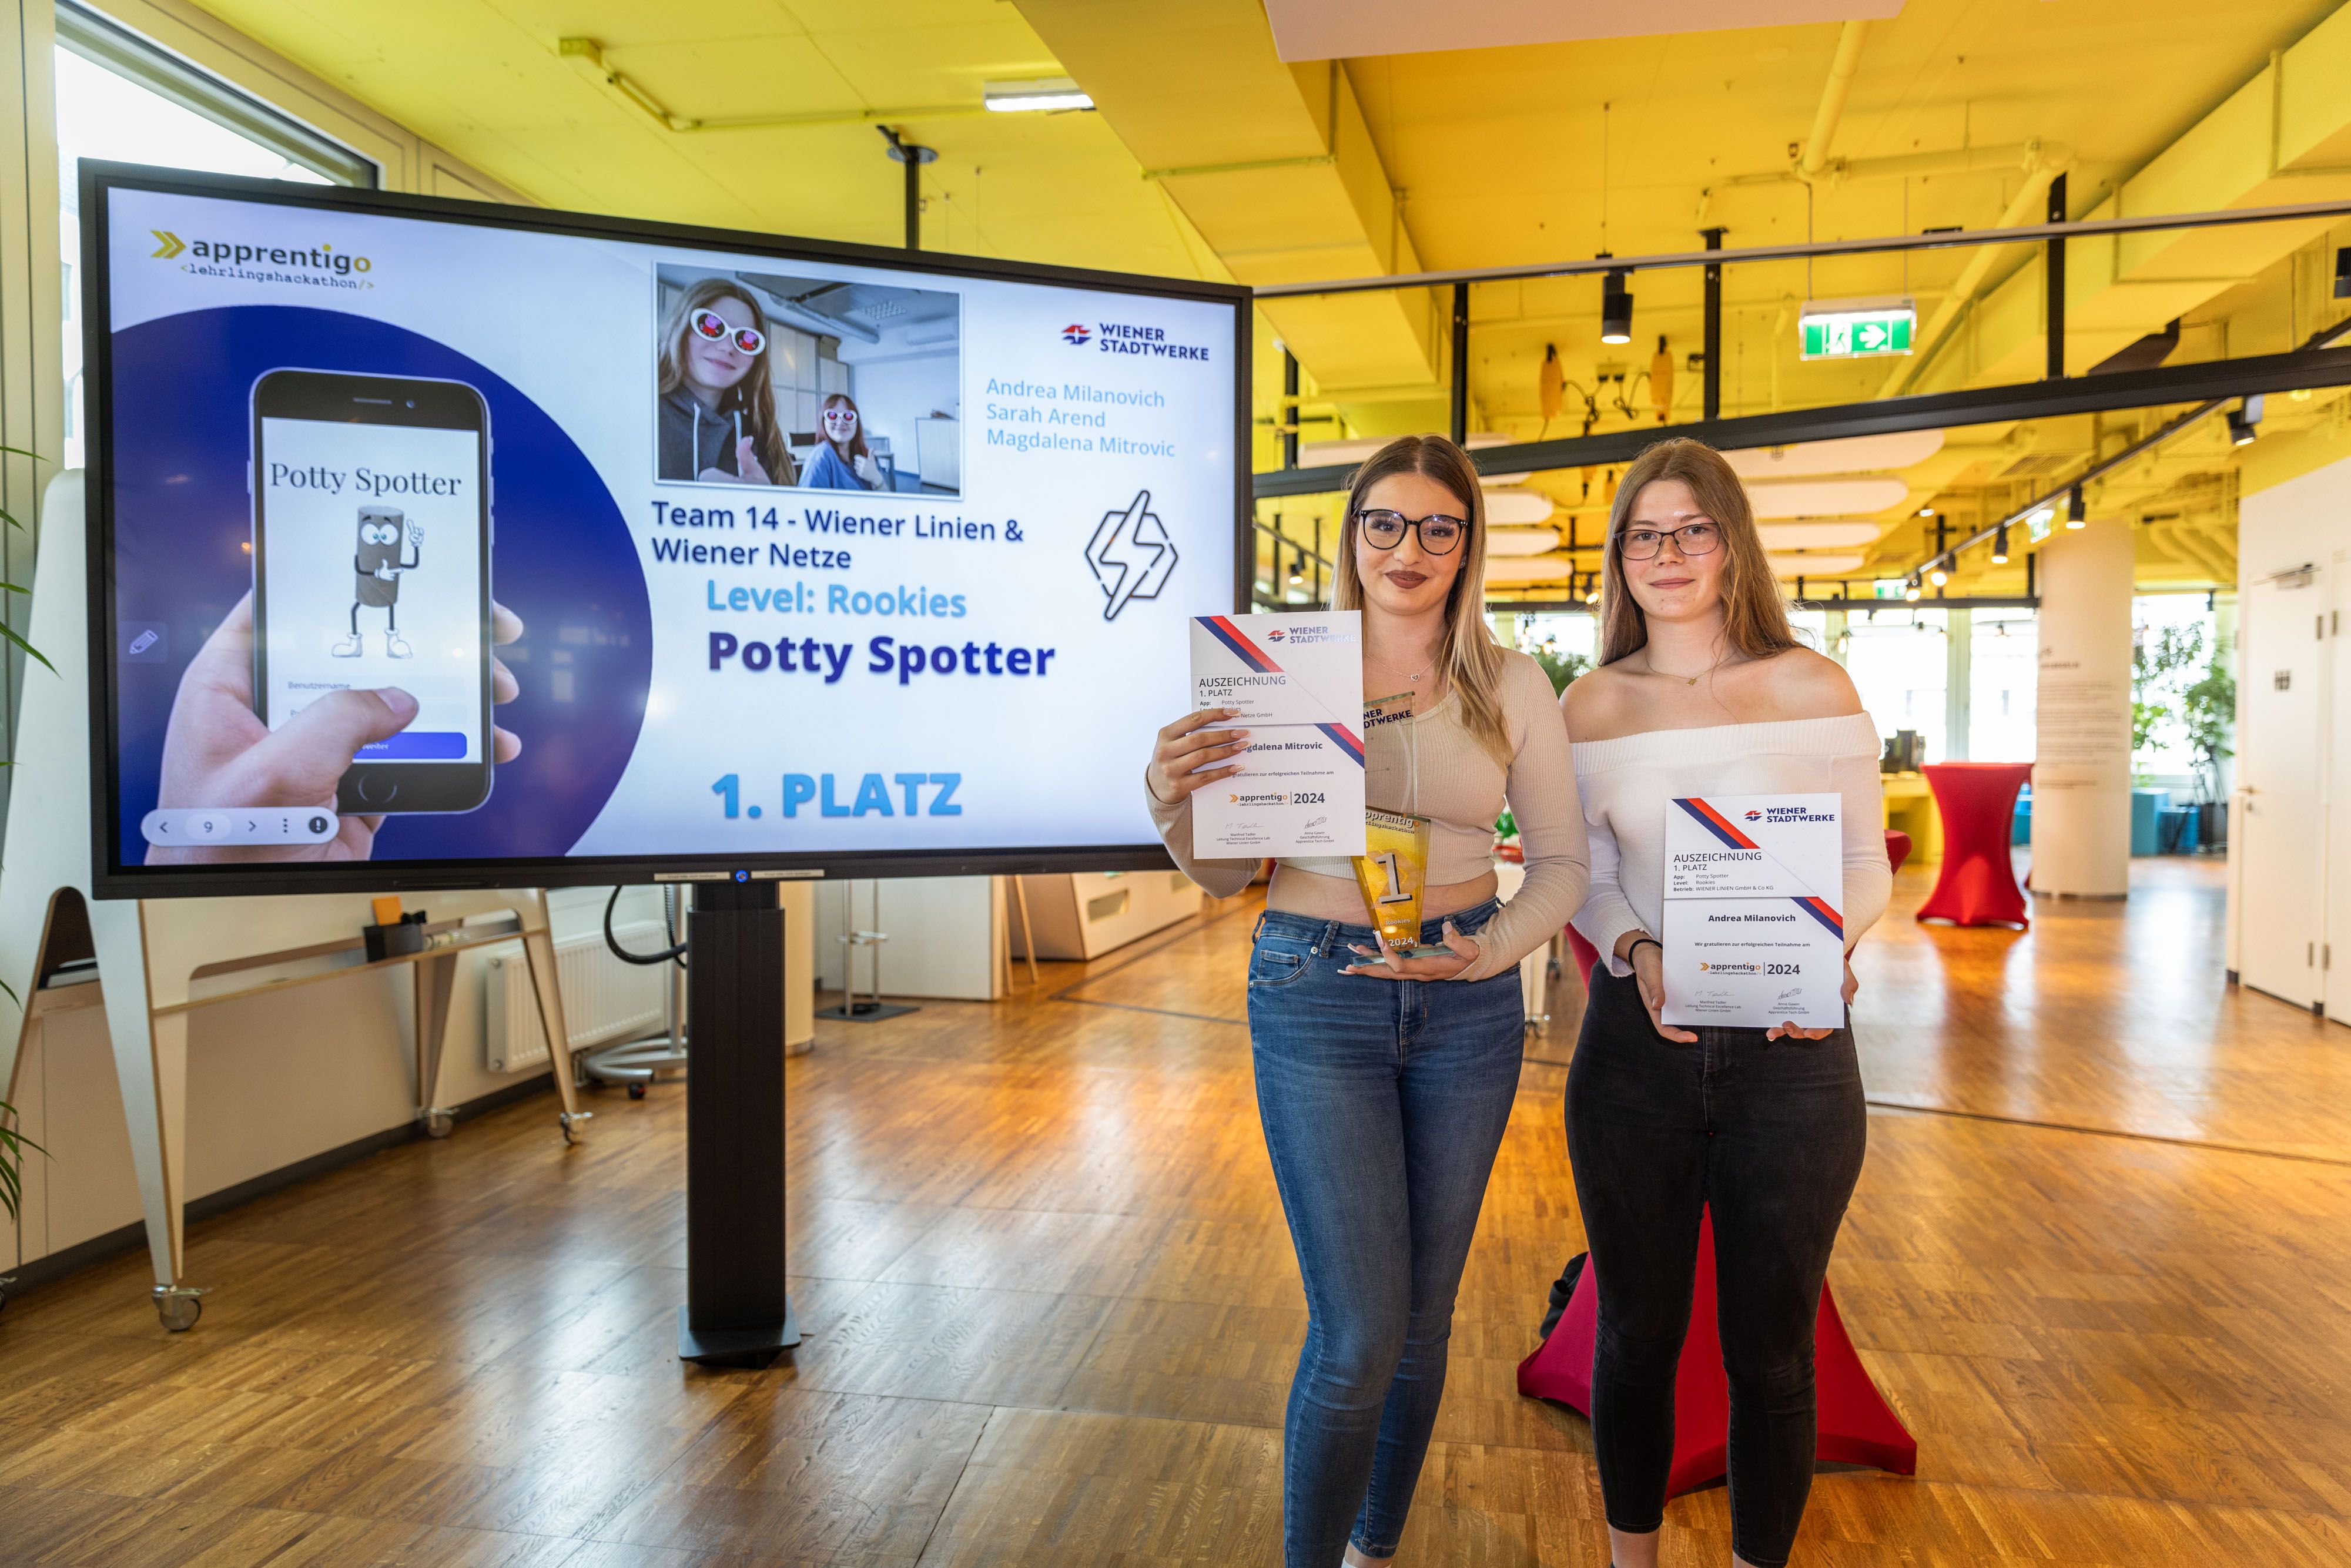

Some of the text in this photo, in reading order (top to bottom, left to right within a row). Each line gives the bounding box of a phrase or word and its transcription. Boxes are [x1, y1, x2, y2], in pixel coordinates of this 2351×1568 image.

[192, 240, 371, 276] apprentigo
[1099, 322, 1164, 341] WIENER
[1100, 339, 1209, 361] STADTWERKE
[986, 378, 1164, 407] Andrea Milanovich
[986, 403, 1106, 428] Sarah Arend
[987, 429, 1175, 457] Magdalena Mitrovic
[269, 463, 462, 497] Potty Spotter
[651, 501, 734, 528] Team
[746, 506, 779, 530] 14
[805, 509, 906, 537] Wiener
[915, 514, 996, 541] Linien
[1004, 519, 1024, 542] &
[651, 537, 852, 568] Wiener Netze
[707, 580, 966, 618] Level: Rookies
[1289, 626, 1328, 635] WIENER
[709, 632, 1056, 685] Potty Spotter
[1199, 676, 1286, 688] AUSZEICHNUNG
[1364, 708, 1382, 719] NER
[1285, 742, 1322, 750] Mitrovic
[711, 773, 962, 818] 1. PLATZ
[1240, 792, 1325, 803] apprentigo 2024
[203, 820, 213, 833] 9
[1365, 811, 1420, 828] pprentigo
[1767, 815, 1835, 823] STADTWERKE
[1673, 852, 1761, 863] AUSZEICHNUNG
[1375, 852, 1412, 904] 1
[1388, 936, 1415, 947] 2024
[1710, 962, 1800, 974] apprentigo 2024
